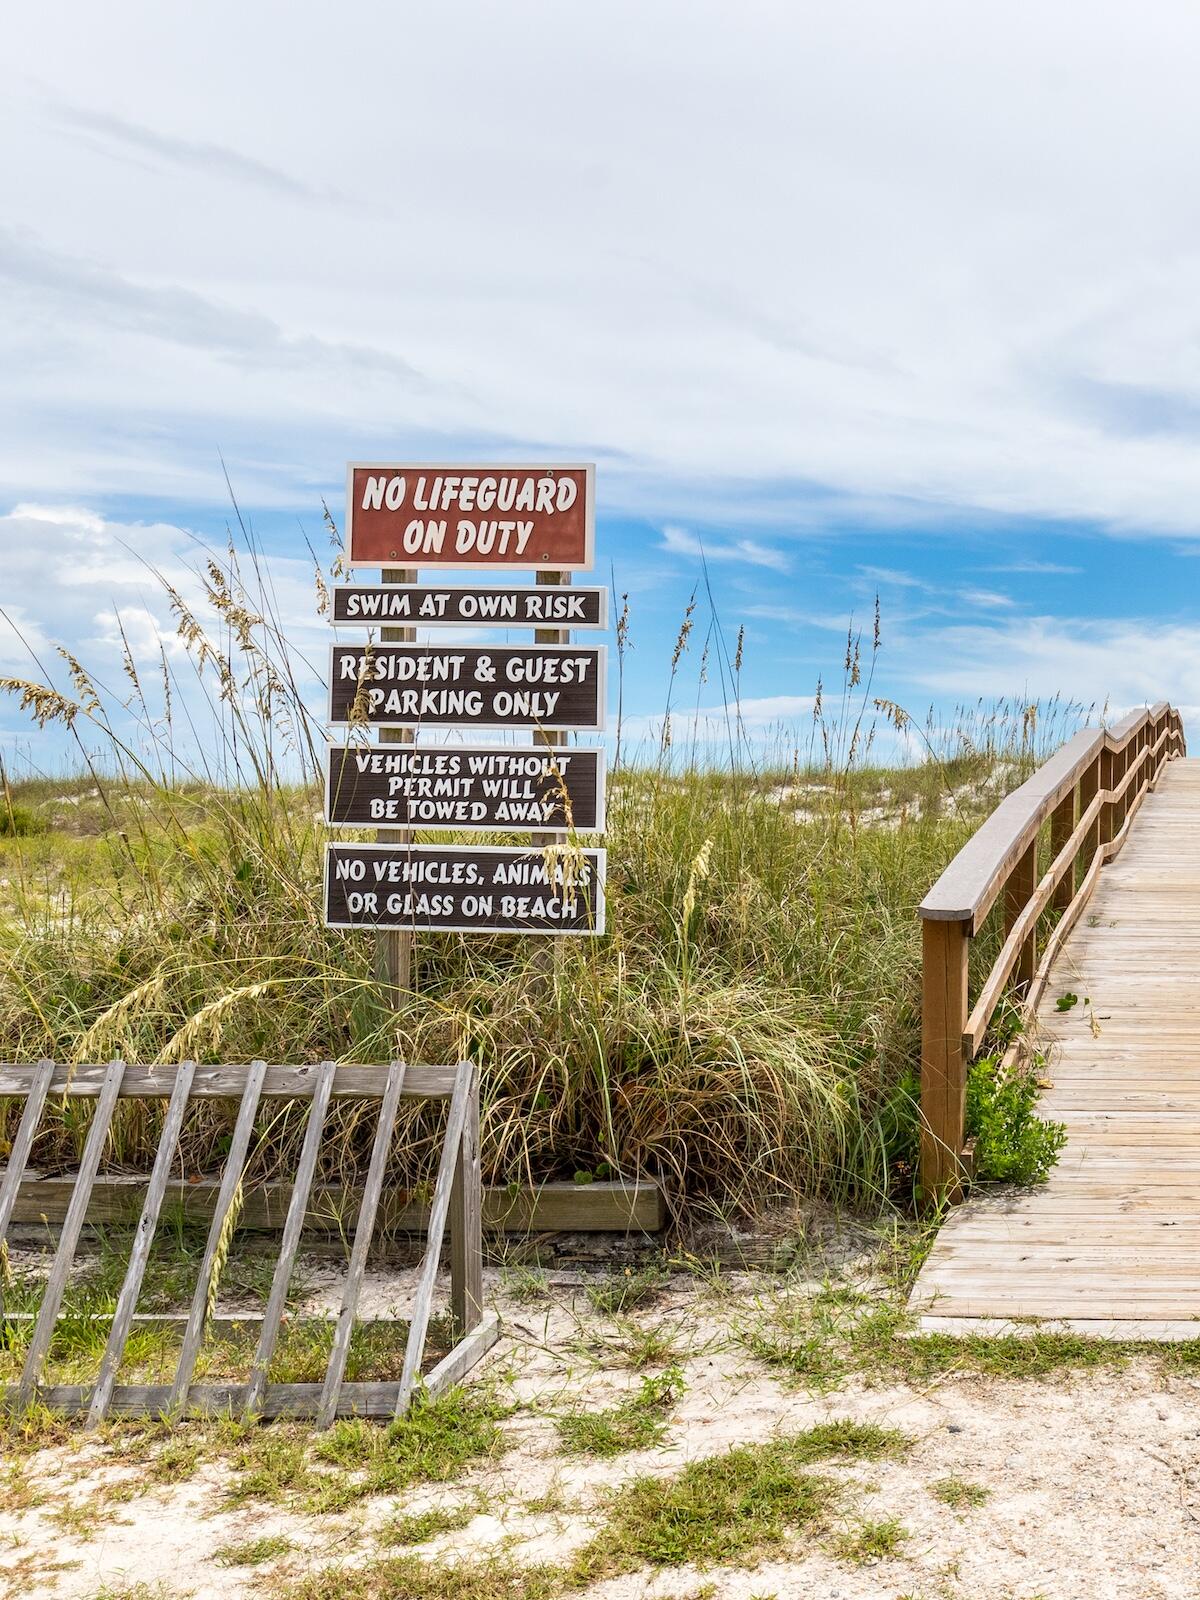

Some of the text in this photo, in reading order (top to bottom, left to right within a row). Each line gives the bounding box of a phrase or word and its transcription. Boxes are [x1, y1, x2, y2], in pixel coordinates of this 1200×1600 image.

[361, 476, 578, 515] NO LIFEGUARD
[403, 519, 534, 555] ON DUTY
[346, 593, 587, 620] SWIM AT OWN RISK
[339, 654, 592, 684] RESIDENT & GUEST
[368, 688, 560, 718] PARKING ONLY
[355, 754, 572, 777] VEHICLES WITHOUT
[388, 777, 536, 800] PERMIT WILL
[370, 799, 555, 822] BE TOWED AWAY
[335, 859, 366, 882] NO
[372, 860, 485, 886] VEHICLES,
[347, 892, 578, 919] OR GLASS ON BEACH
